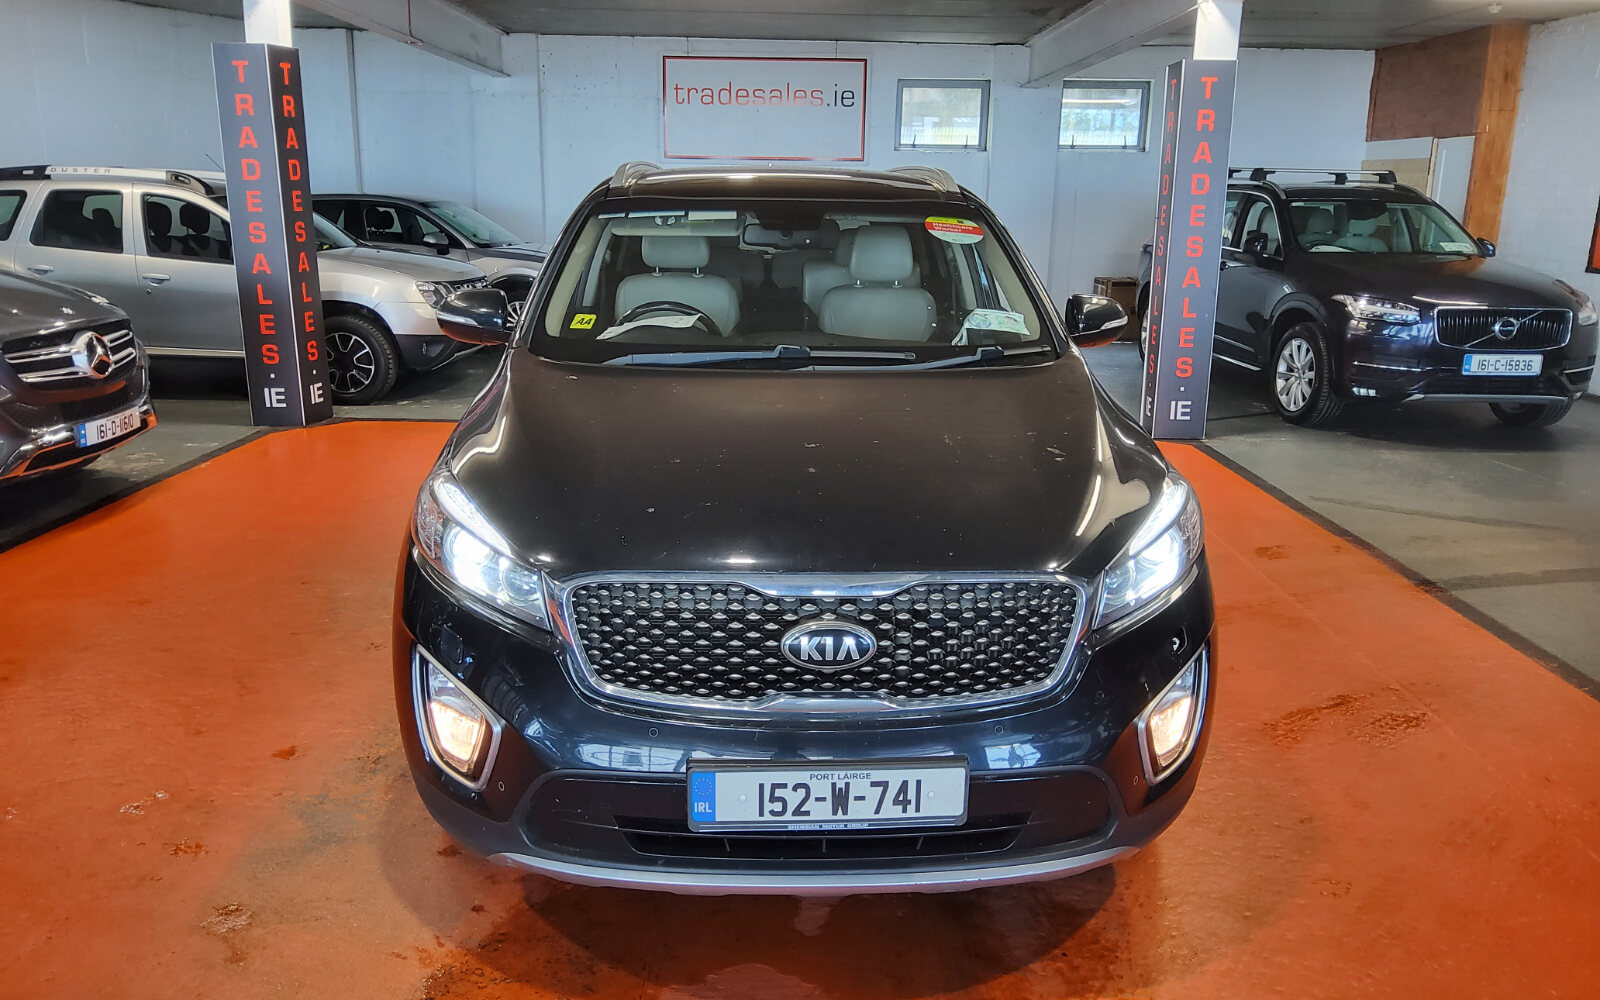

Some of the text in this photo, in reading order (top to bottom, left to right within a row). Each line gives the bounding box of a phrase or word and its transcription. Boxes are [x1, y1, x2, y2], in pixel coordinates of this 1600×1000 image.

[673, 81, 855, 108] tradesales.ie
[575, 317, 593, 326] AA
[1477, 359, 1533, 371] 161-C-15836
[799, 636, 860, 661] KIA
[809, 771, 872, 781] PORT LÁIRGE
[758, 779, 922, 817] 152-W-741
[694, 801, 713, 813] IRL
